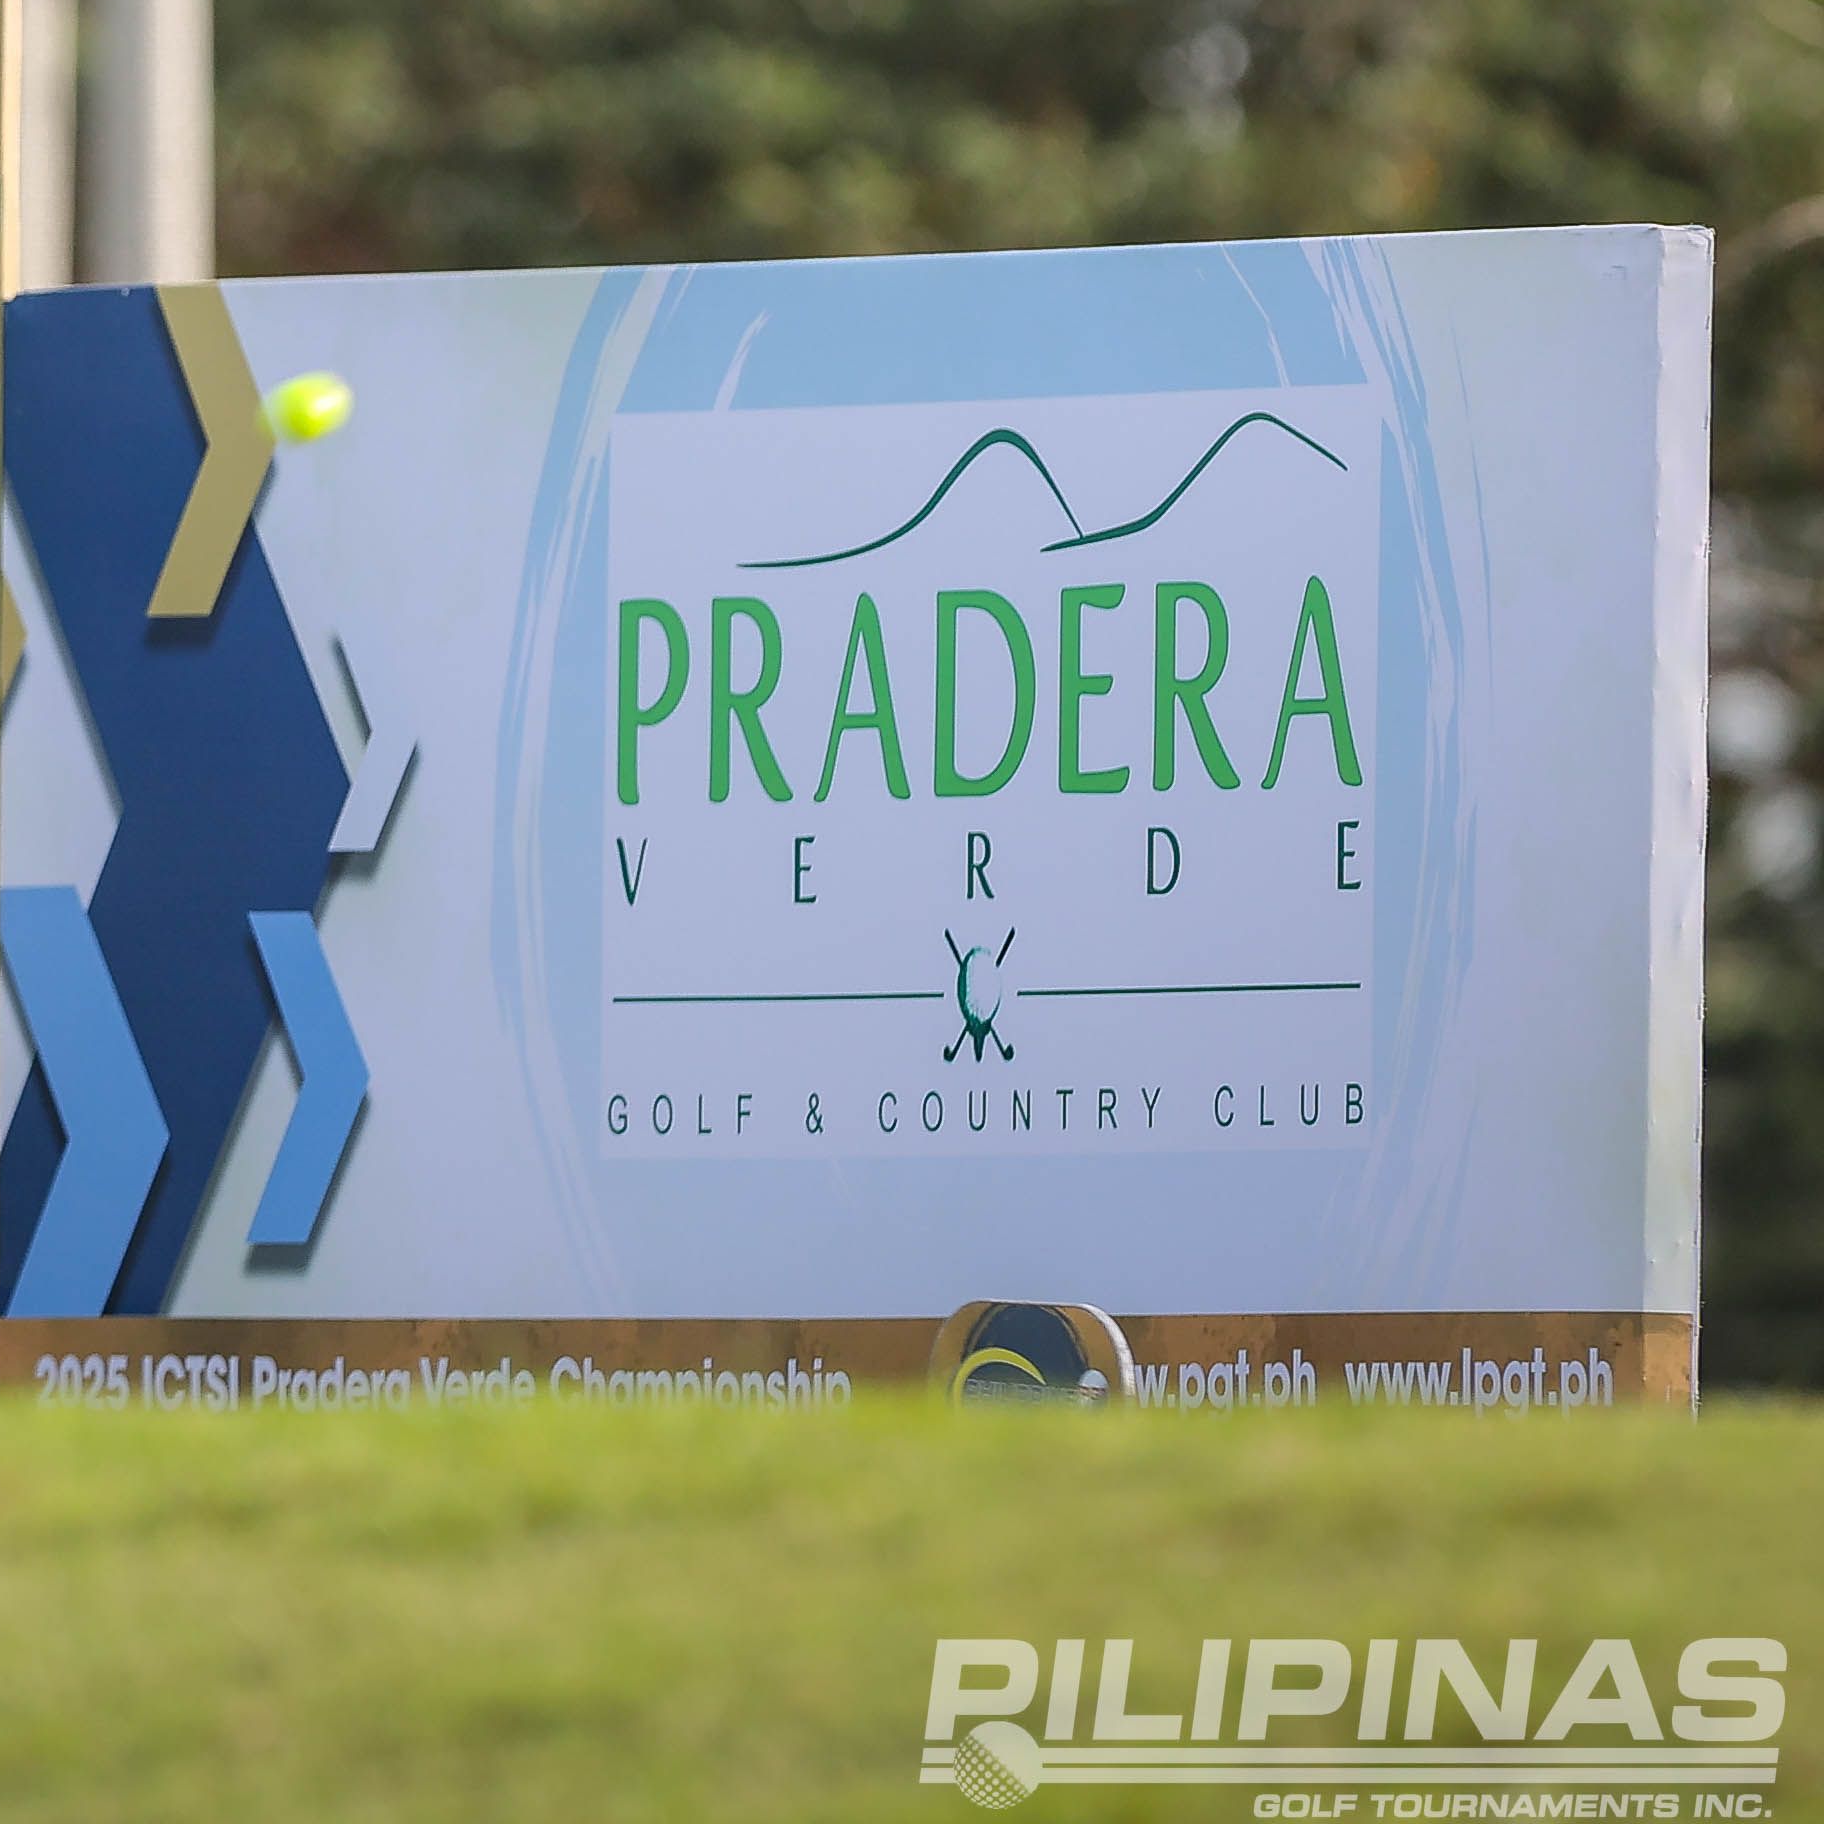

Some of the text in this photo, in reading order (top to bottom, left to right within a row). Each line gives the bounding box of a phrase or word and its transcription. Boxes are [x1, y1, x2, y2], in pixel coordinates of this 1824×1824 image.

[618, 576, 1362, 805] PRADERA
[617, 821, 1362, 905] VERDE
[607, 1083, 1365, 1135] GOLF & COUNTRY CLUB
[35, 1353, 852, 1412] 2025 ICTSI Pradera Verde Championship
[1134, 1347, 1614, 1419] w.pgt.ph www.lpgt.ph
